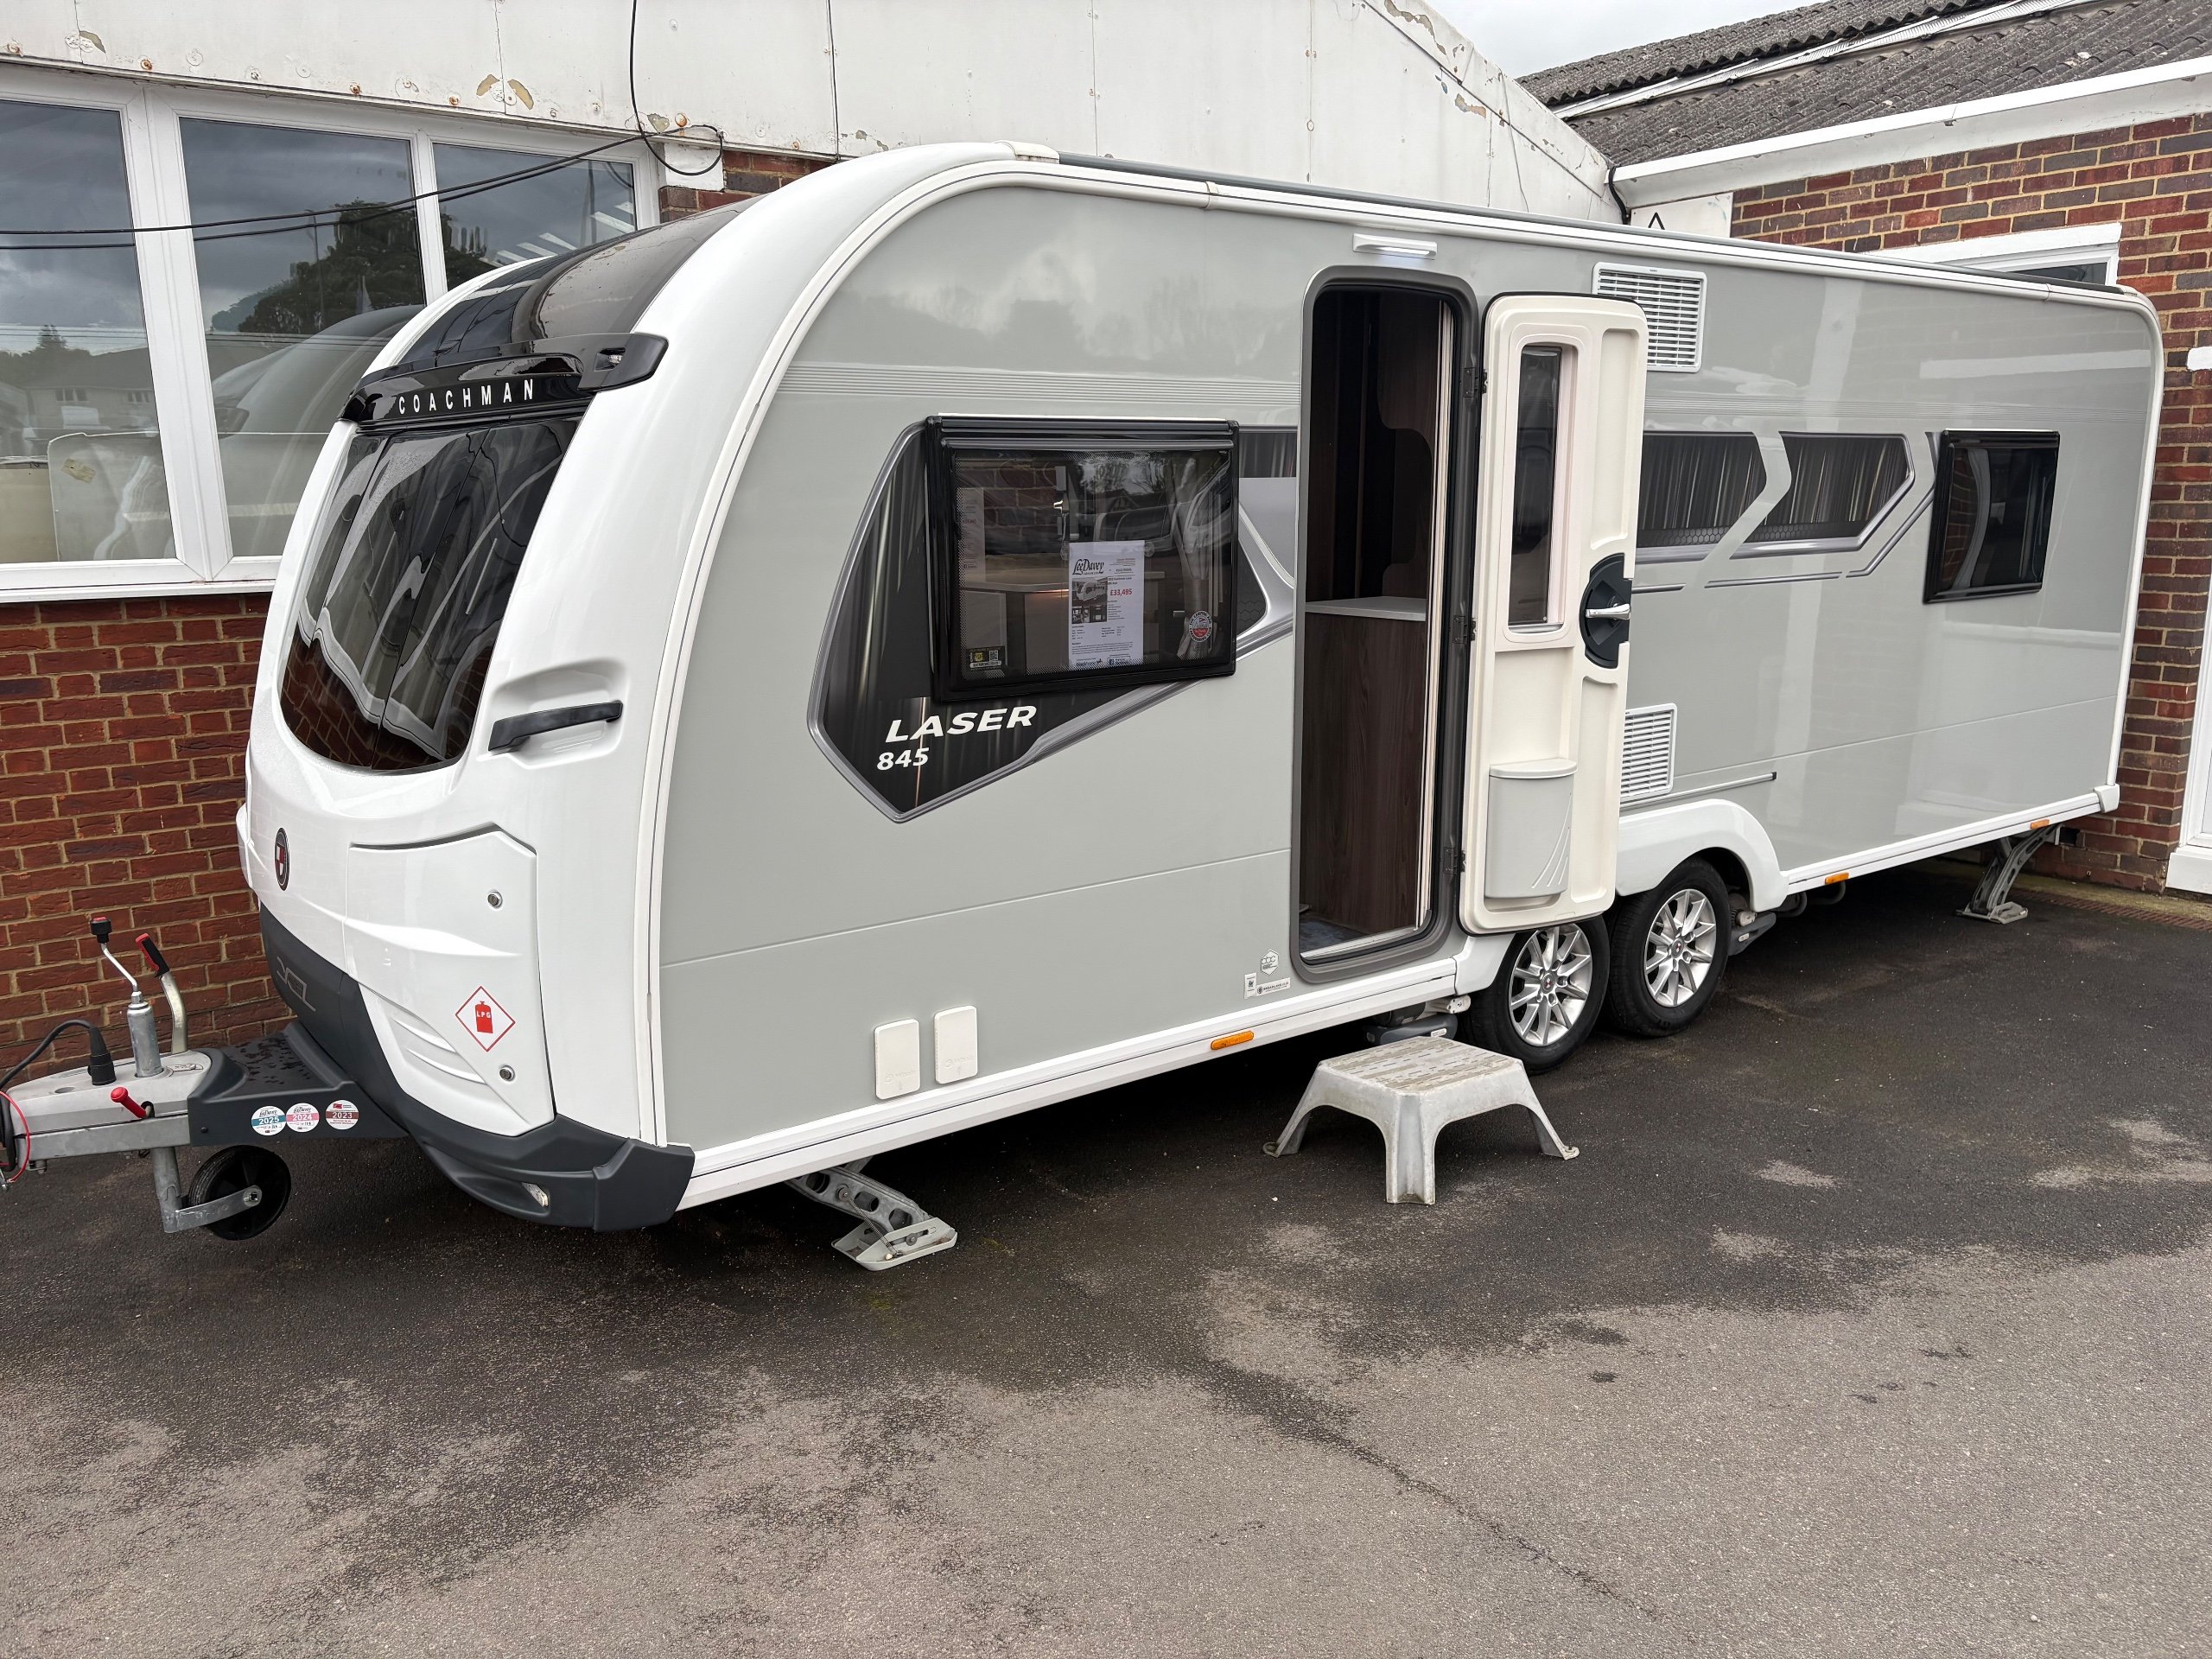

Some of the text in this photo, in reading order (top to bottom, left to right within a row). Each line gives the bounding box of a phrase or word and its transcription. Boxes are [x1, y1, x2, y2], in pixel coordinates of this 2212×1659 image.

[398, 378, 534, 415] COACHMAN
[886, 705, 1037, 743] LASER
[876, 747, 930, 771] 845
[258, 1116, 280, 1125] 2025
